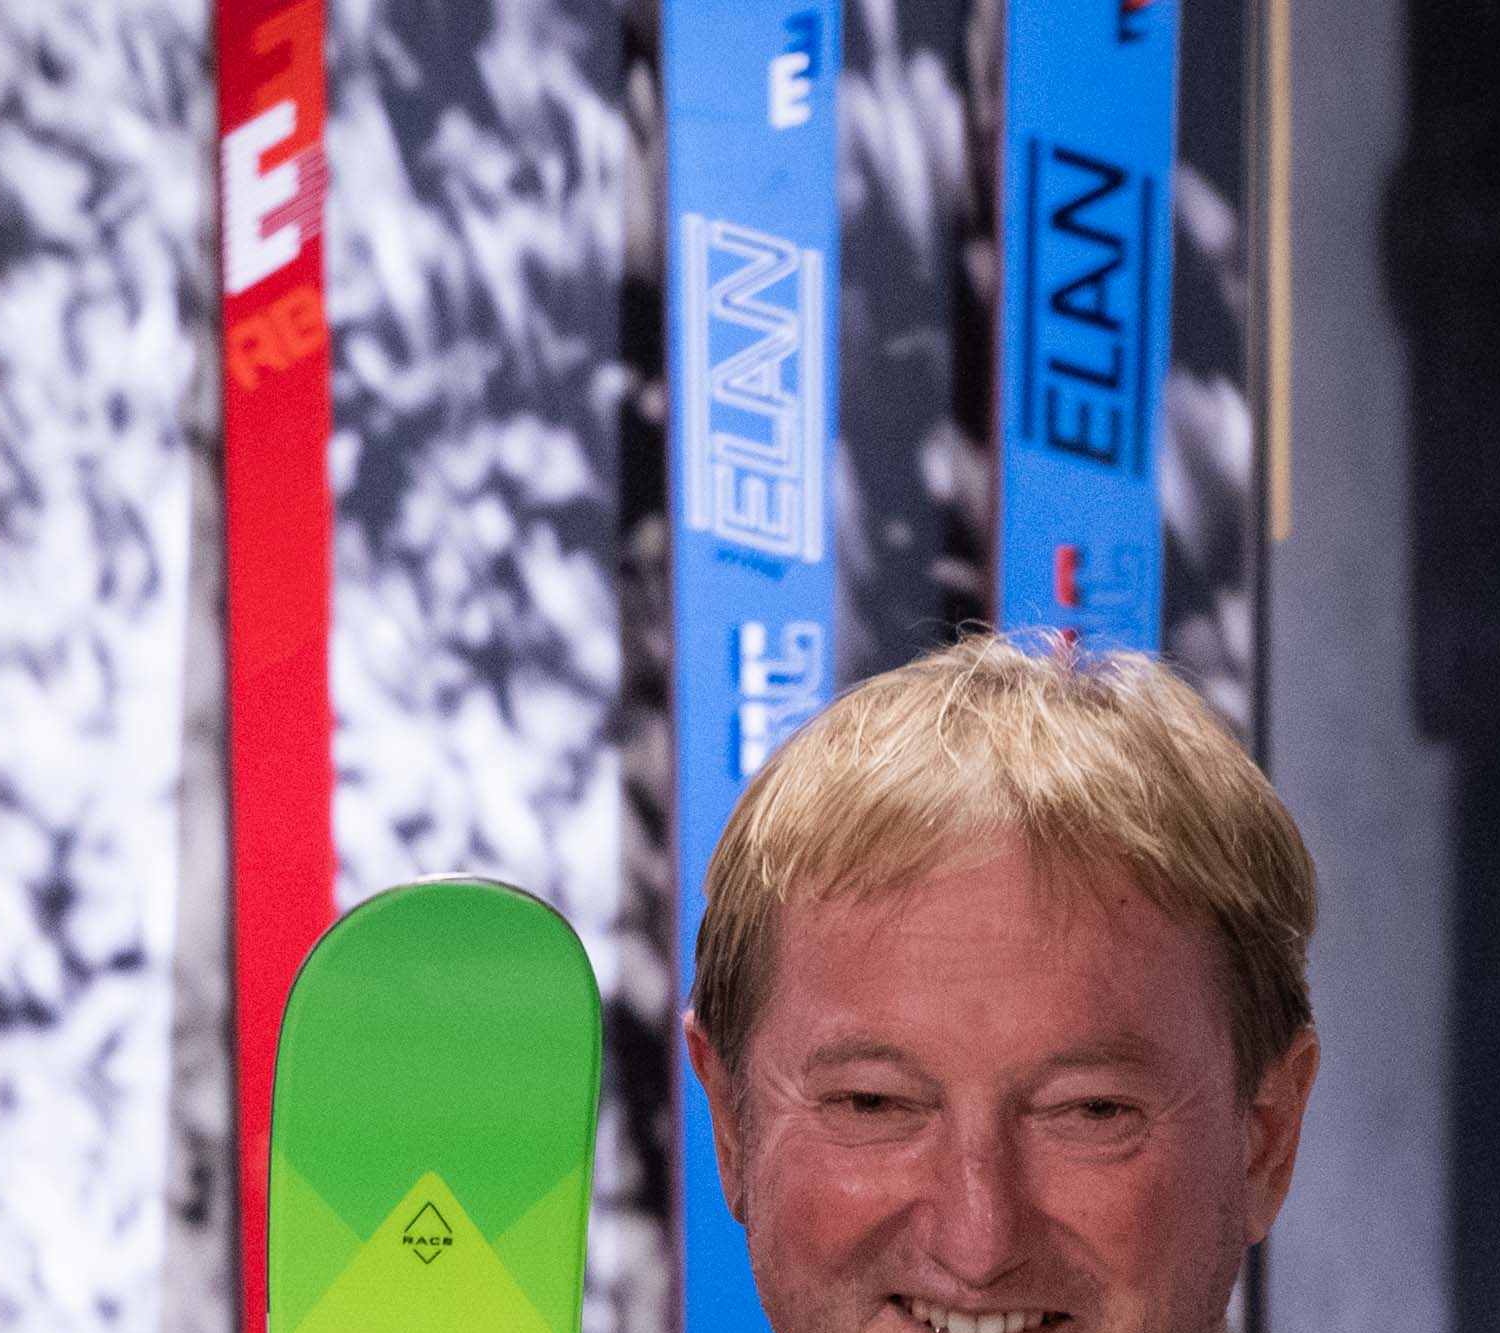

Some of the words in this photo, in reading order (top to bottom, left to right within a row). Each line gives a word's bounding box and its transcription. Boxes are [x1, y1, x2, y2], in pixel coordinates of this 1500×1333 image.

[709, 219, 801, 556] ELAN
[1048, 147, 1126, 466] ELAN
[402, 1236, 453, 1246] RACE
